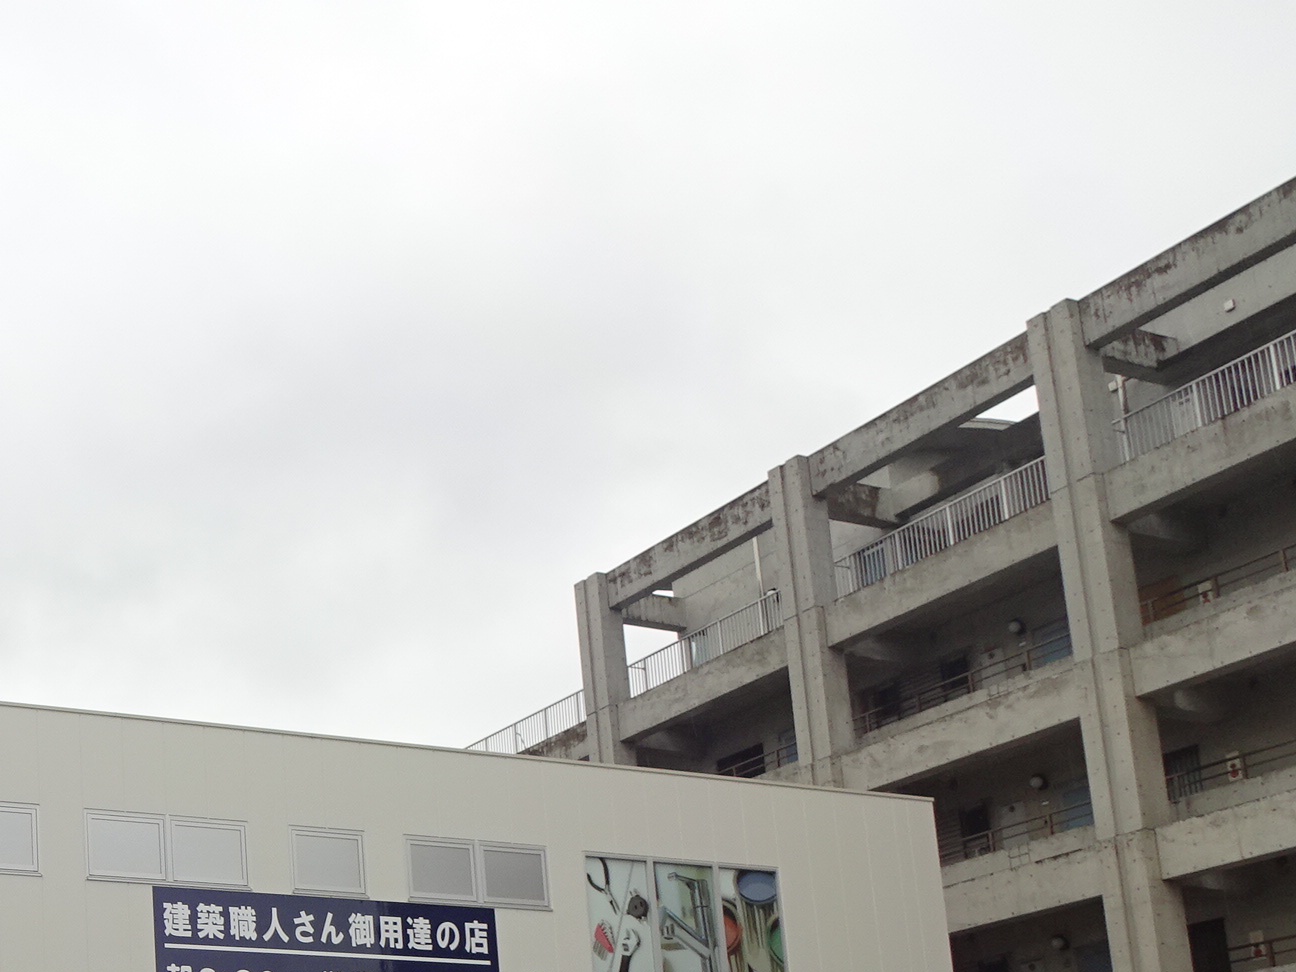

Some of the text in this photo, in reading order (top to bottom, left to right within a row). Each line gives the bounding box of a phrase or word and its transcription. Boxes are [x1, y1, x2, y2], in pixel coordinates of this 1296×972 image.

[162, 902, 490, 955] 建築職人さん御用達の店
